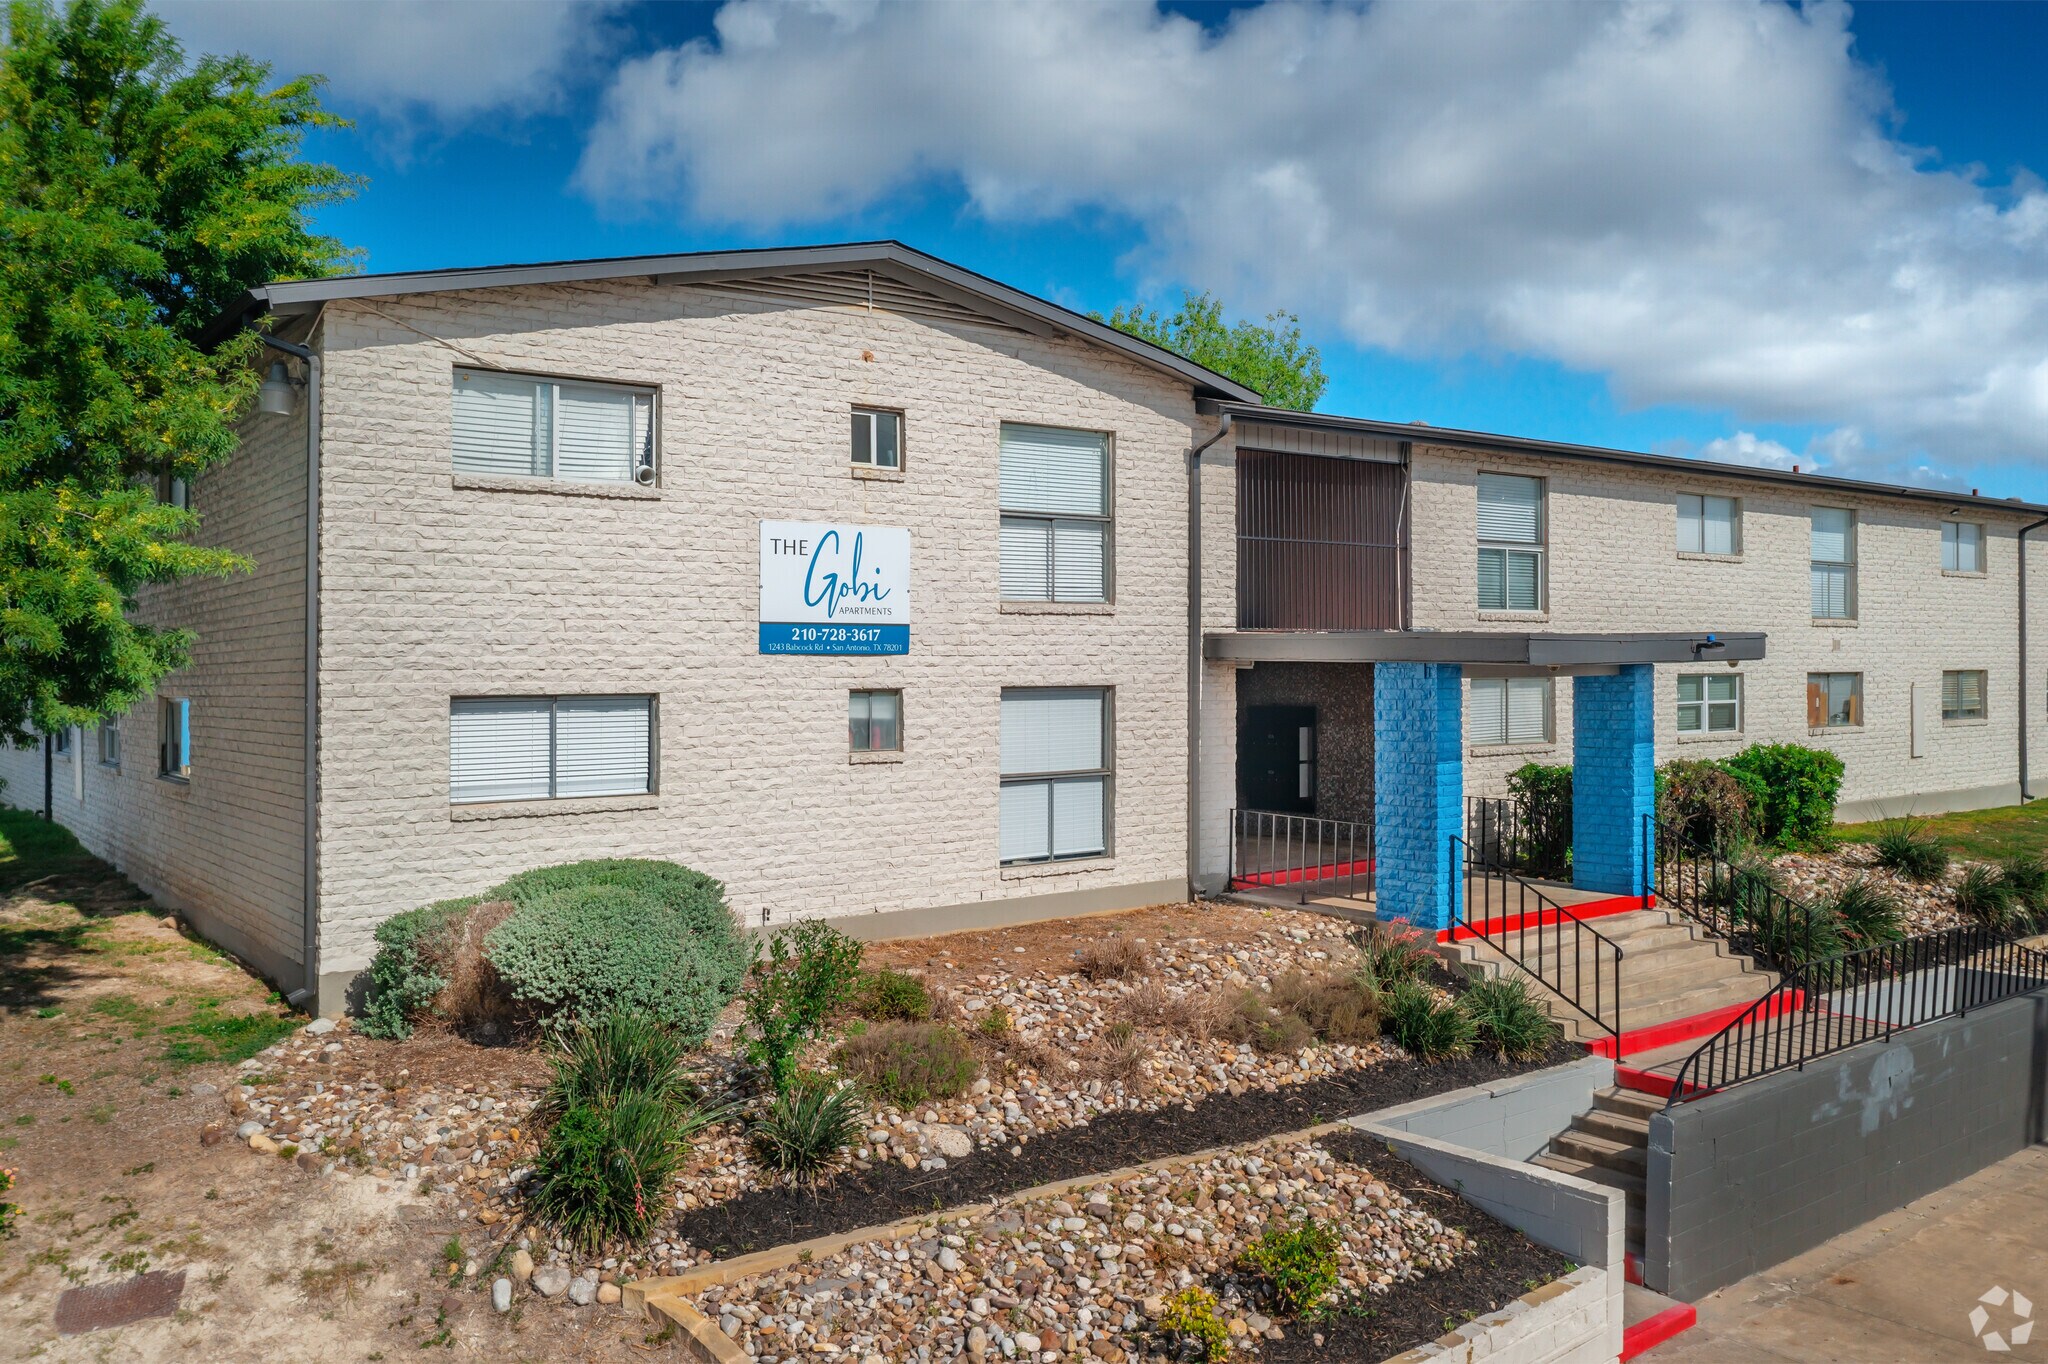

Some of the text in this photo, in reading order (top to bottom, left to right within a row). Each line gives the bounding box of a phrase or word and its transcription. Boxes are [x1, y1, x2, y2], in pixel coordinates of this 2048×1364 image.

[770, 530, 891, 619] THE Gobi
[839, 606, 892, 616] APARTMENTS
[791, 627, 881, 641] 210-728-3617
[769, 643, 785, 651] 1243
[785, 643, 813, 651] Babcock
[814, 643, 824, 651] Rd
